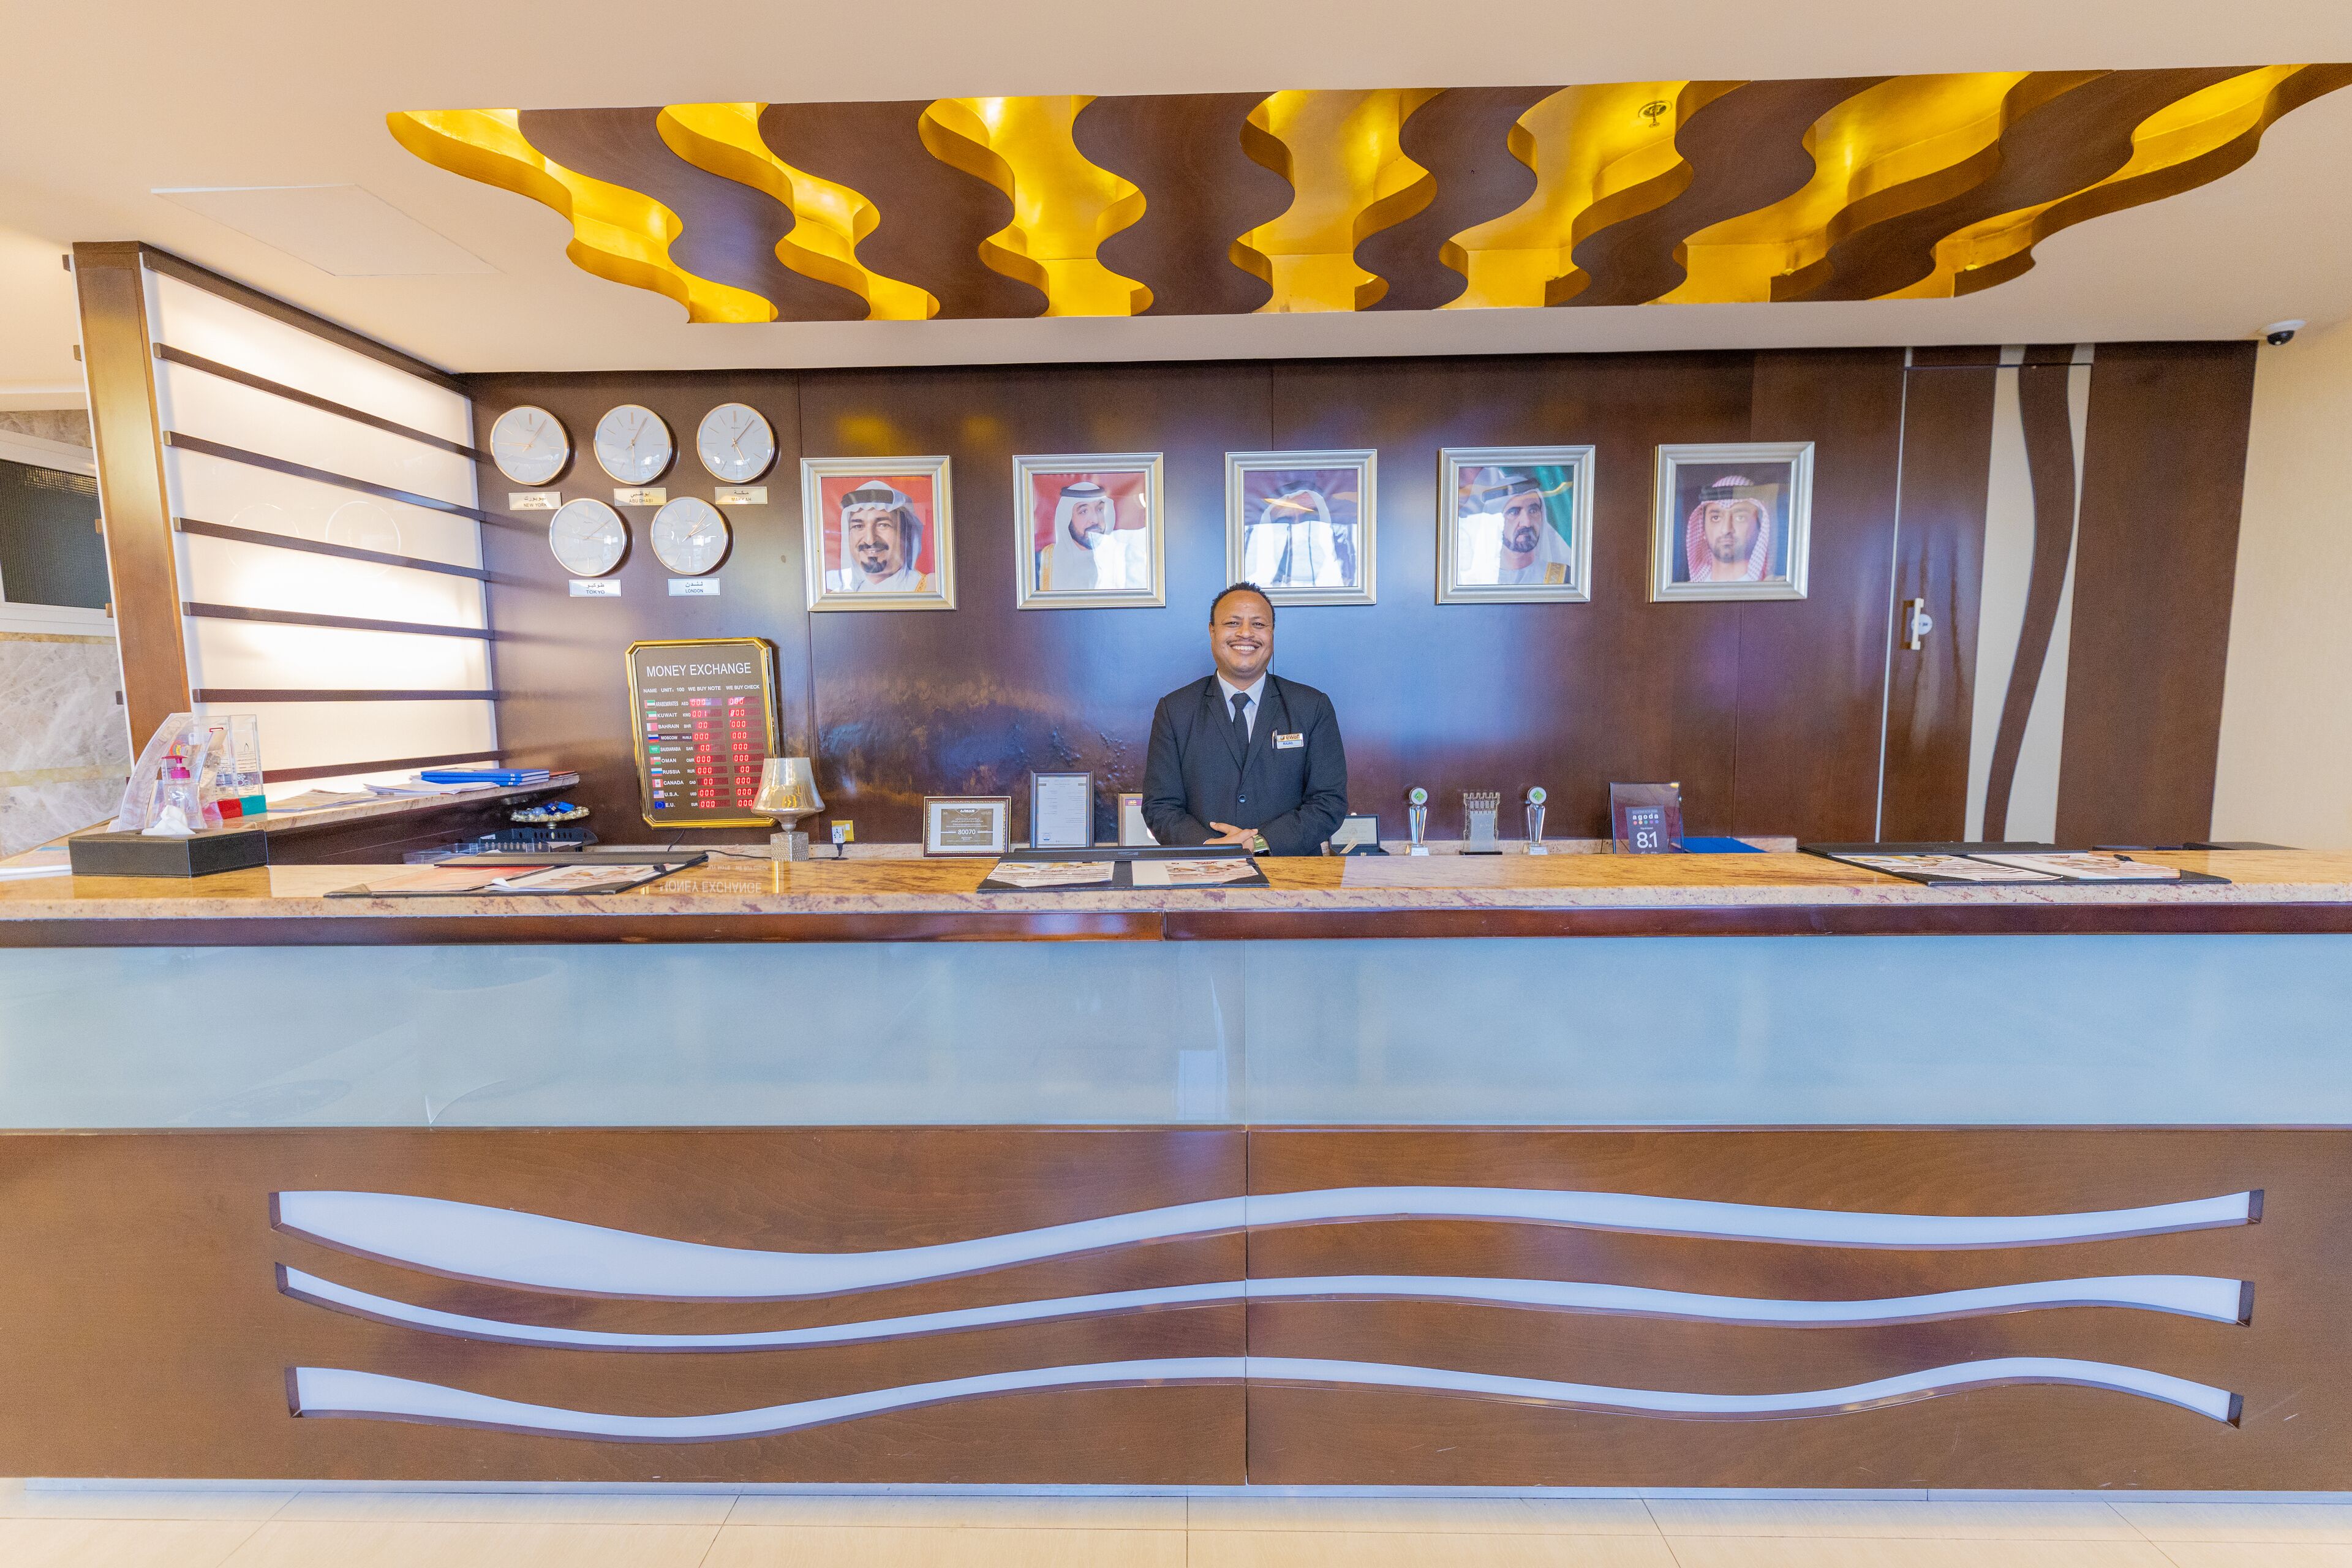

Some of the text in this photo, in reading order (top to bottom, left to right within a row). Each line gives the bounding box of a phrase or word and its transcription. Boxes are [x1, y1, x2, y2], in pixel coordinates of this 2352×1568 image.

[646, 662, 752, 677] MONEY EXCHANGE
[1637, 831, 1657, 849] 8.1
